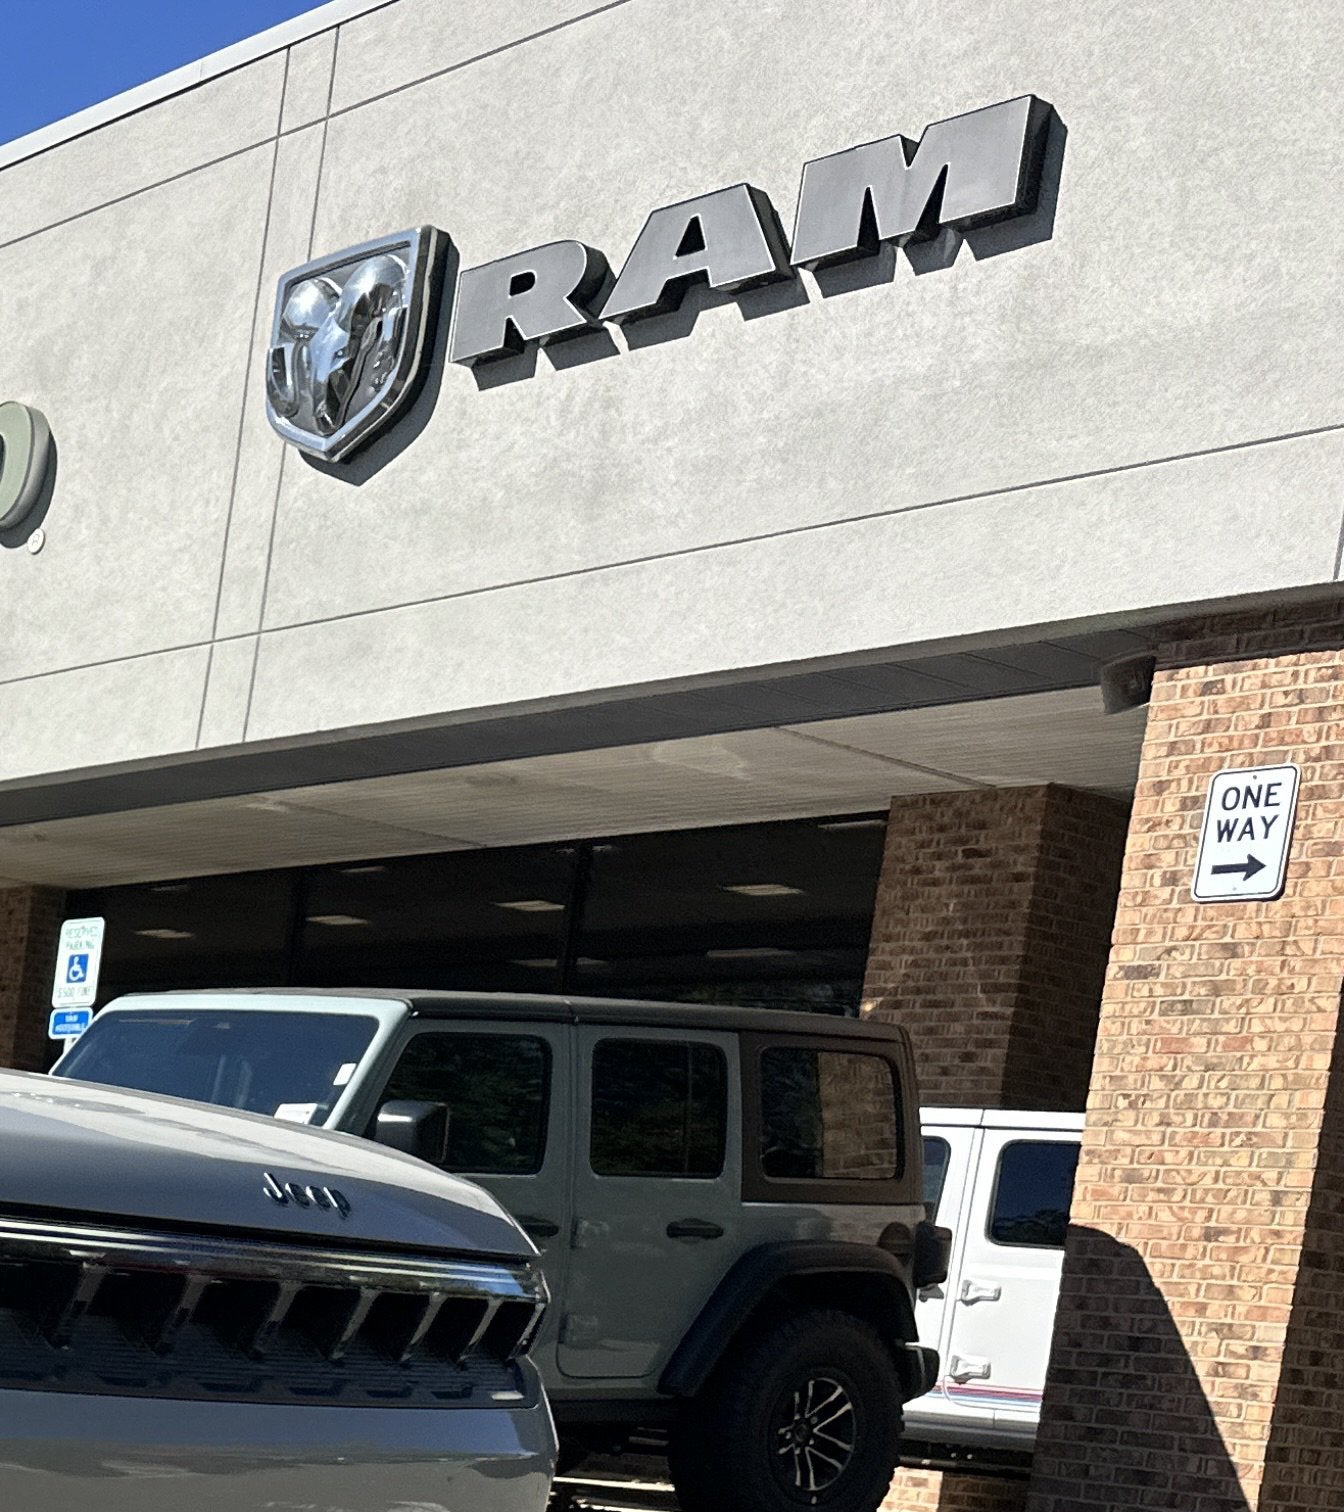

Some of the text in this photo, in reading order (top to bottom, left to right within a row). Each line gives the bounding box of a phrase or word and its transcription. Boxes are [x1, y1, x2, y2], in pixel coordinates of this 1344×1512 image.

[448, 93, 1042, 364] RAM
[1221, 781, 1283, 811] ONE
[1216, 813, 1281, 844] WAY
[263, 1172, 352, 1219] Jeep
